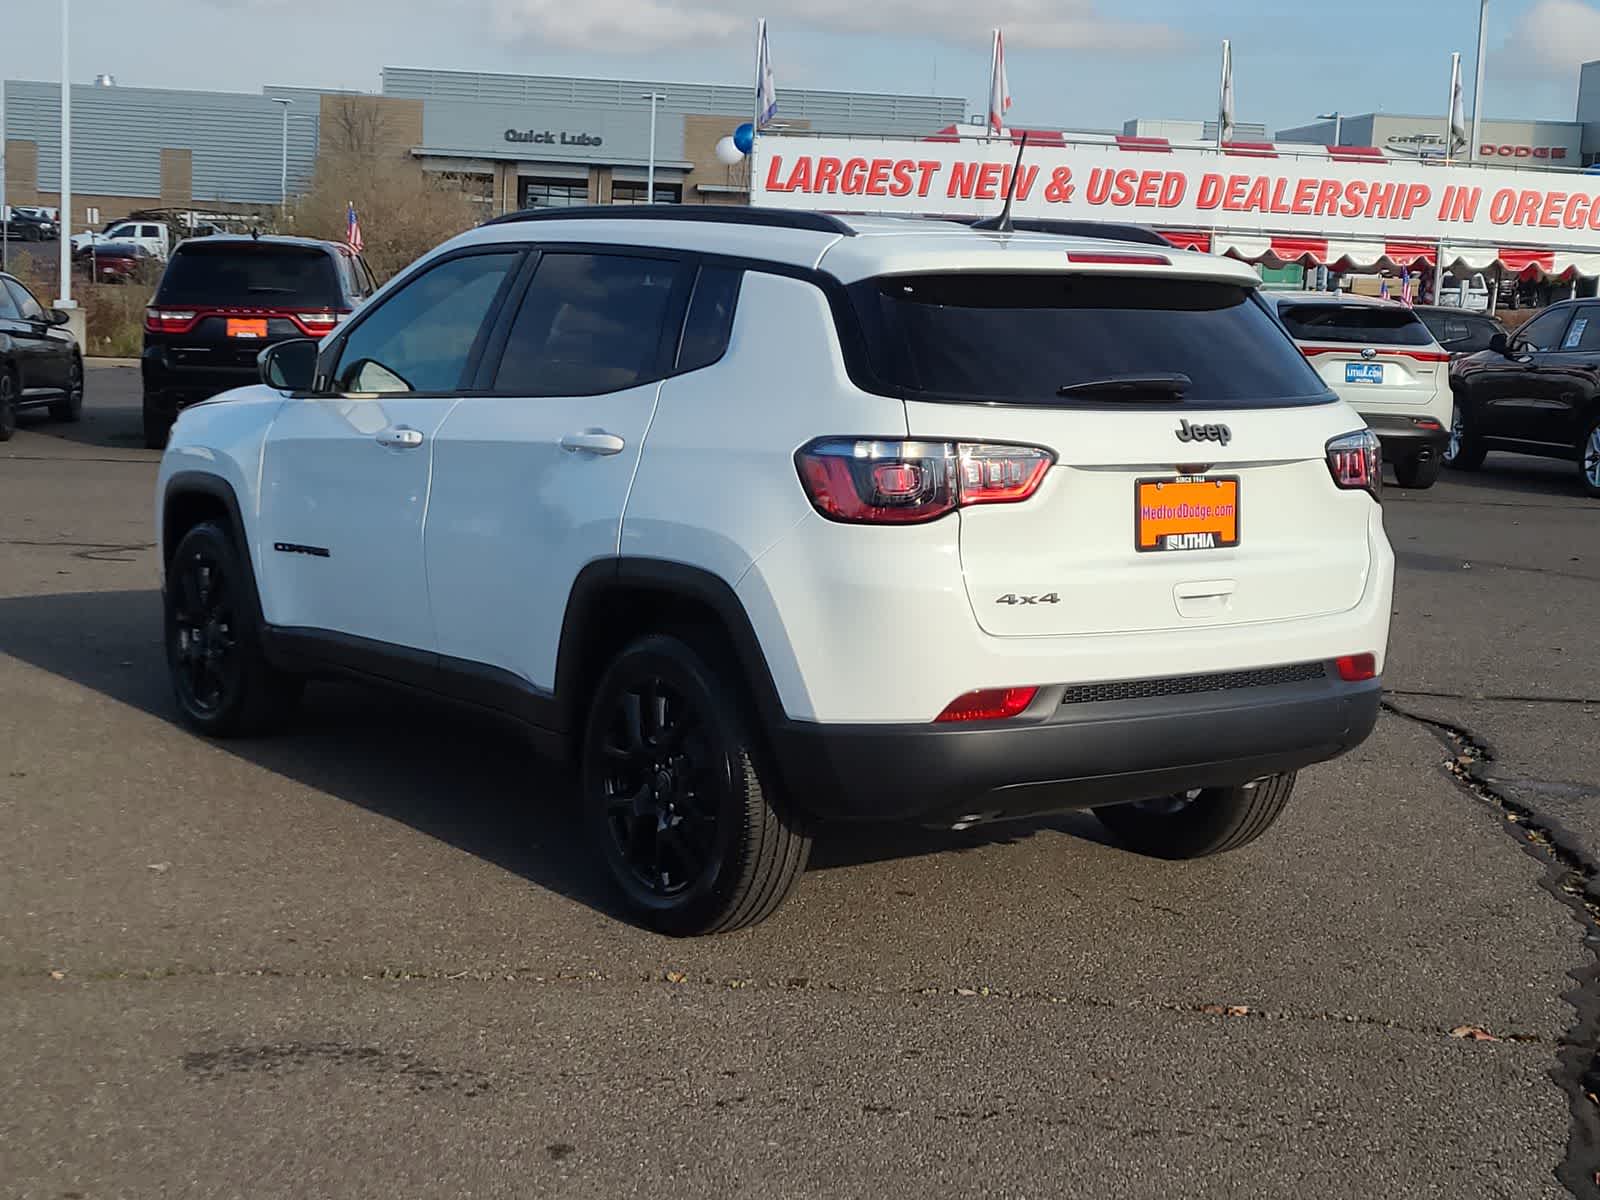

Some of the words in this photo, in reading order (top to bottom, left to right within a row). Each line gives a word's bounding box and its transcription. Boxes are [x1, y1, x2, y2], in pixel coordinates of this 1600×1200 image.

[504, 129, 556, 144] Quick
[560, 131, 602, 146] Lube
[1480, 143, 1569, 160] DODGE
[765, 155, 942, 199] LARGEST
[946, 161, 1040, 201] NEW
[1044, 166, 1076, 204] &
[1086, 167, 1188, 209] USED
[1196, 173, 1431, 221] DEALERSHIP
[1437, 184, 1482, 223] IN
[1175, 418, 1232, 447] Jeep
[1142, 503, 1234, 521] MedfordDodge.com
[1180, 532, 1215, 548] LITHIA
[996, 592, 1061, 605] 4x4
